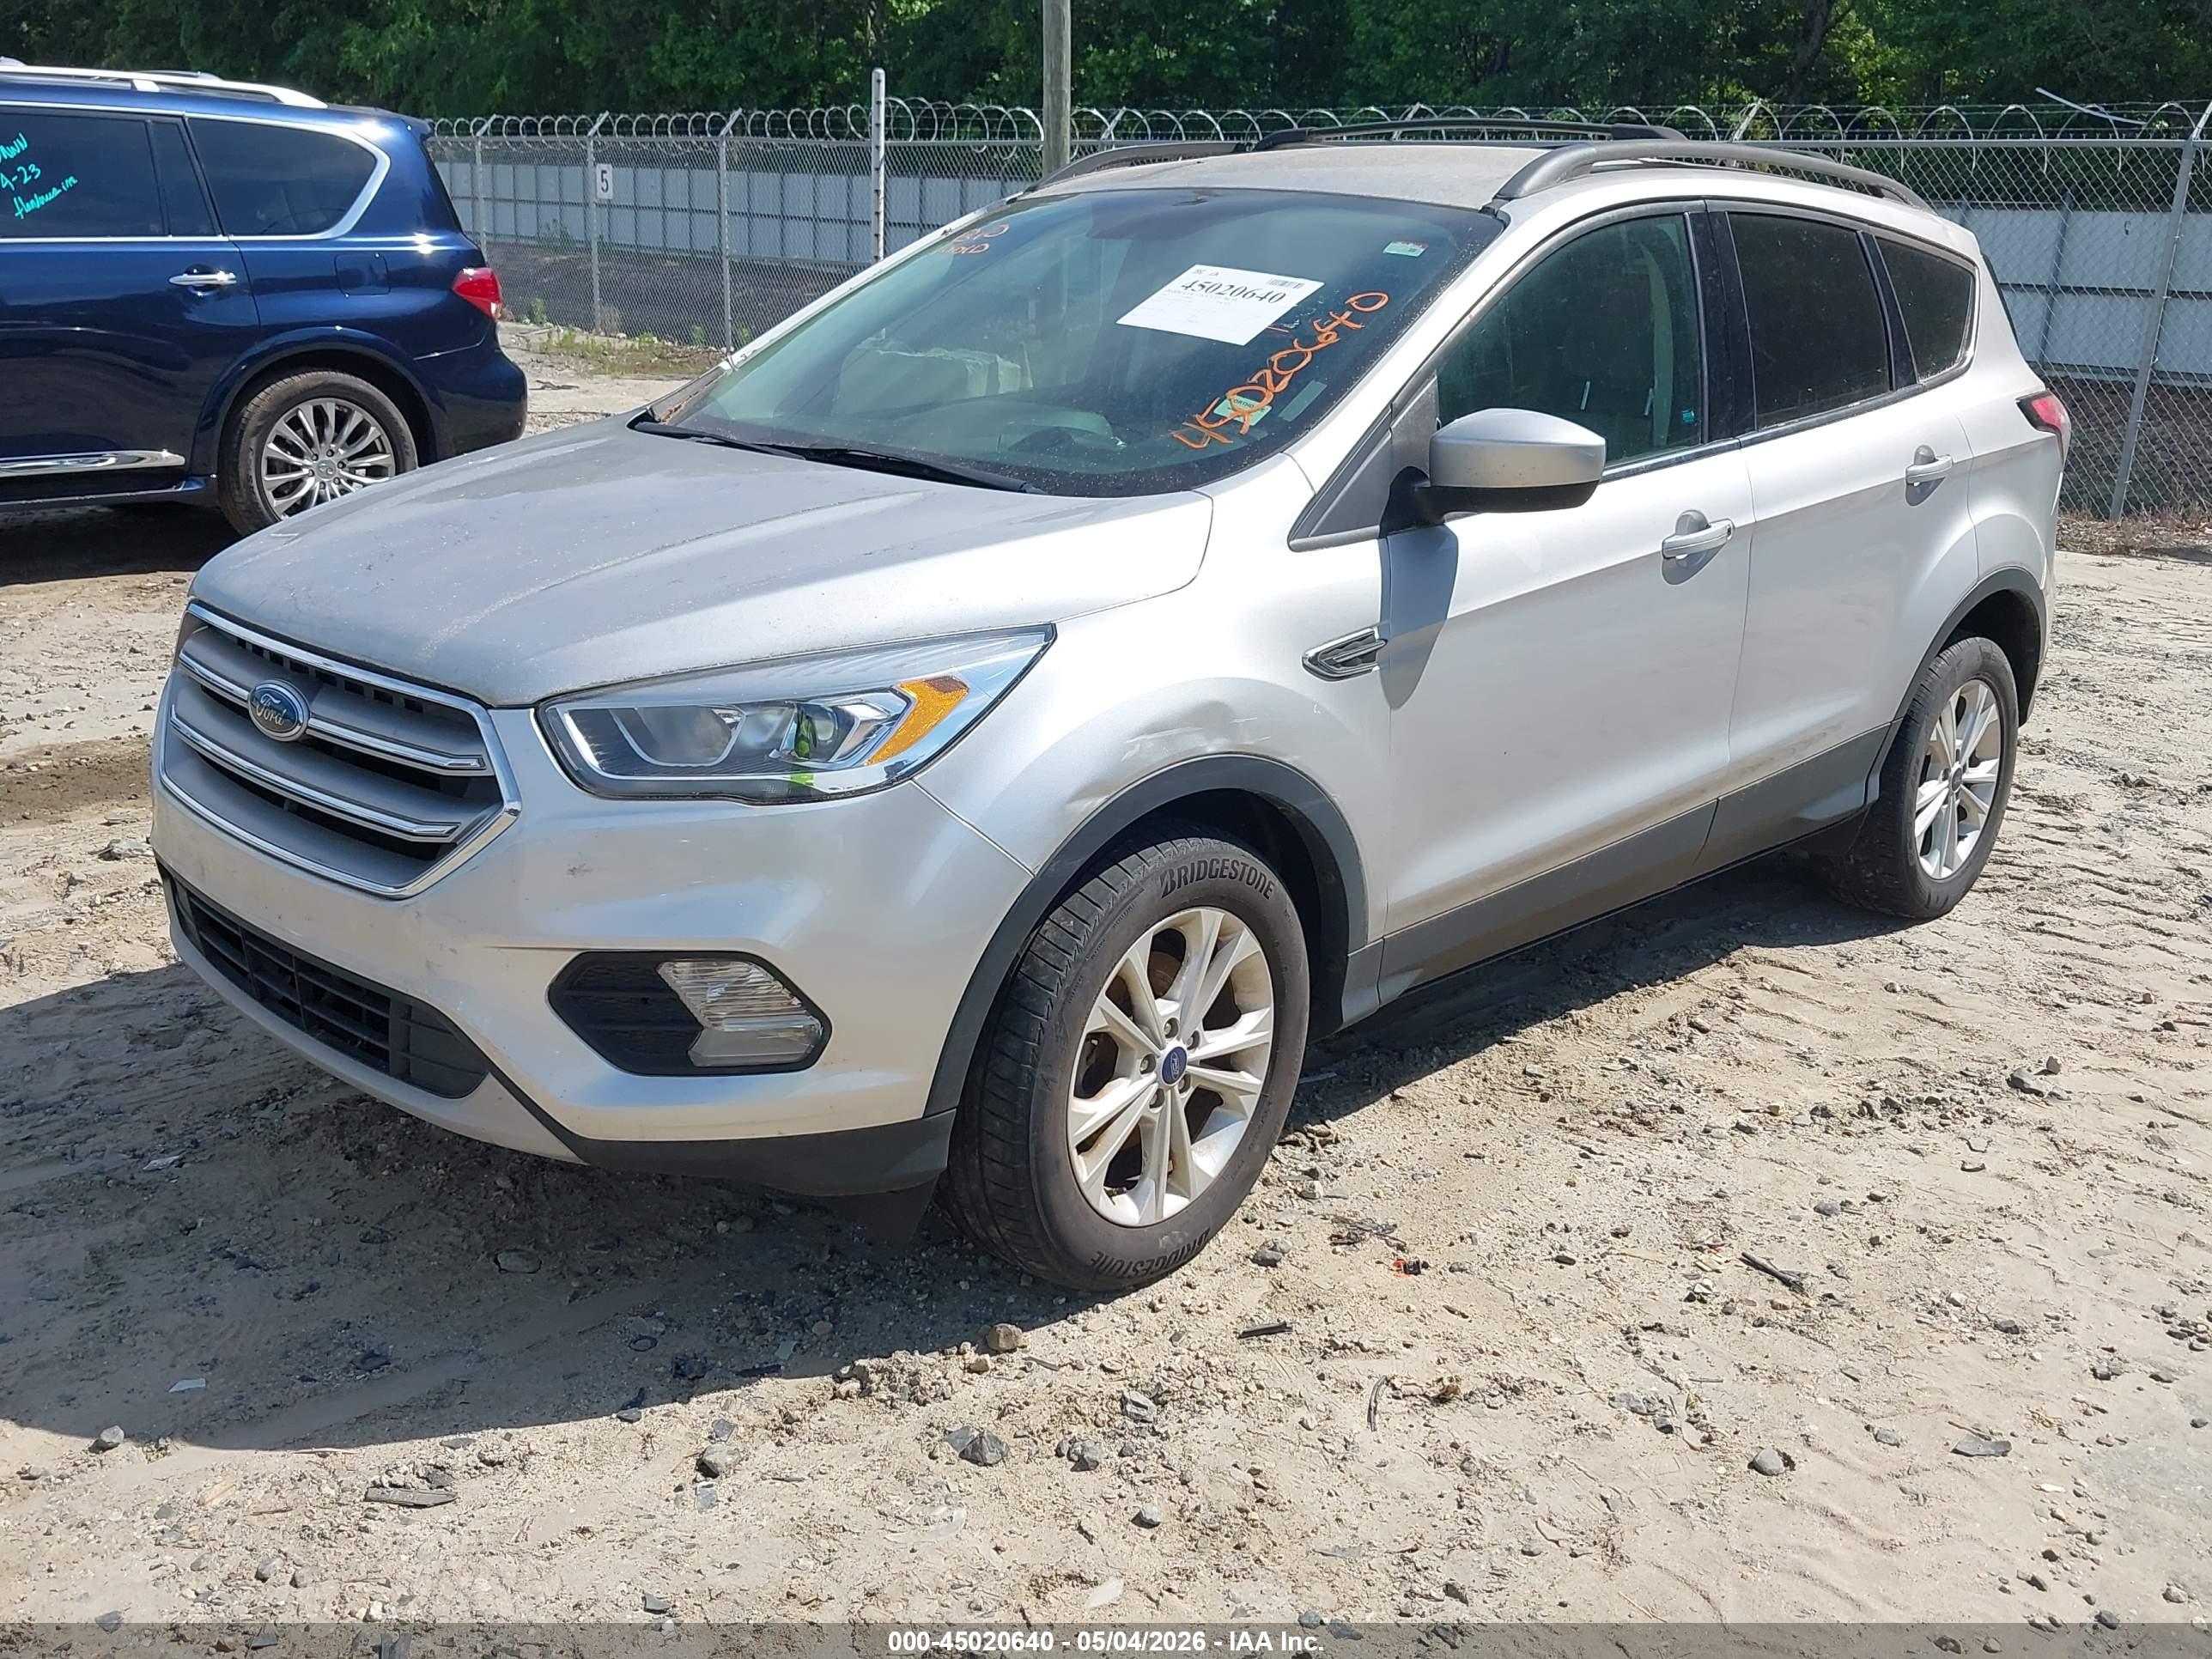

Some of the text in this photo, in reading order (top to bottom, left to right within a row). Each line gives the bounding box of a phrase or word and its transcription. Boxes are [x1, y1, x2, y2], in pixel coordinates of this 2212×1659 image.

[600, 169, 609, 193] 5
[1181, 279, 1286, 304] 45020640
[1169, 292, 1389, 449] 45020640
[256, 693, 288, 726] Ford
[1160, 858, 1275, 900] BRIDGESTONE
